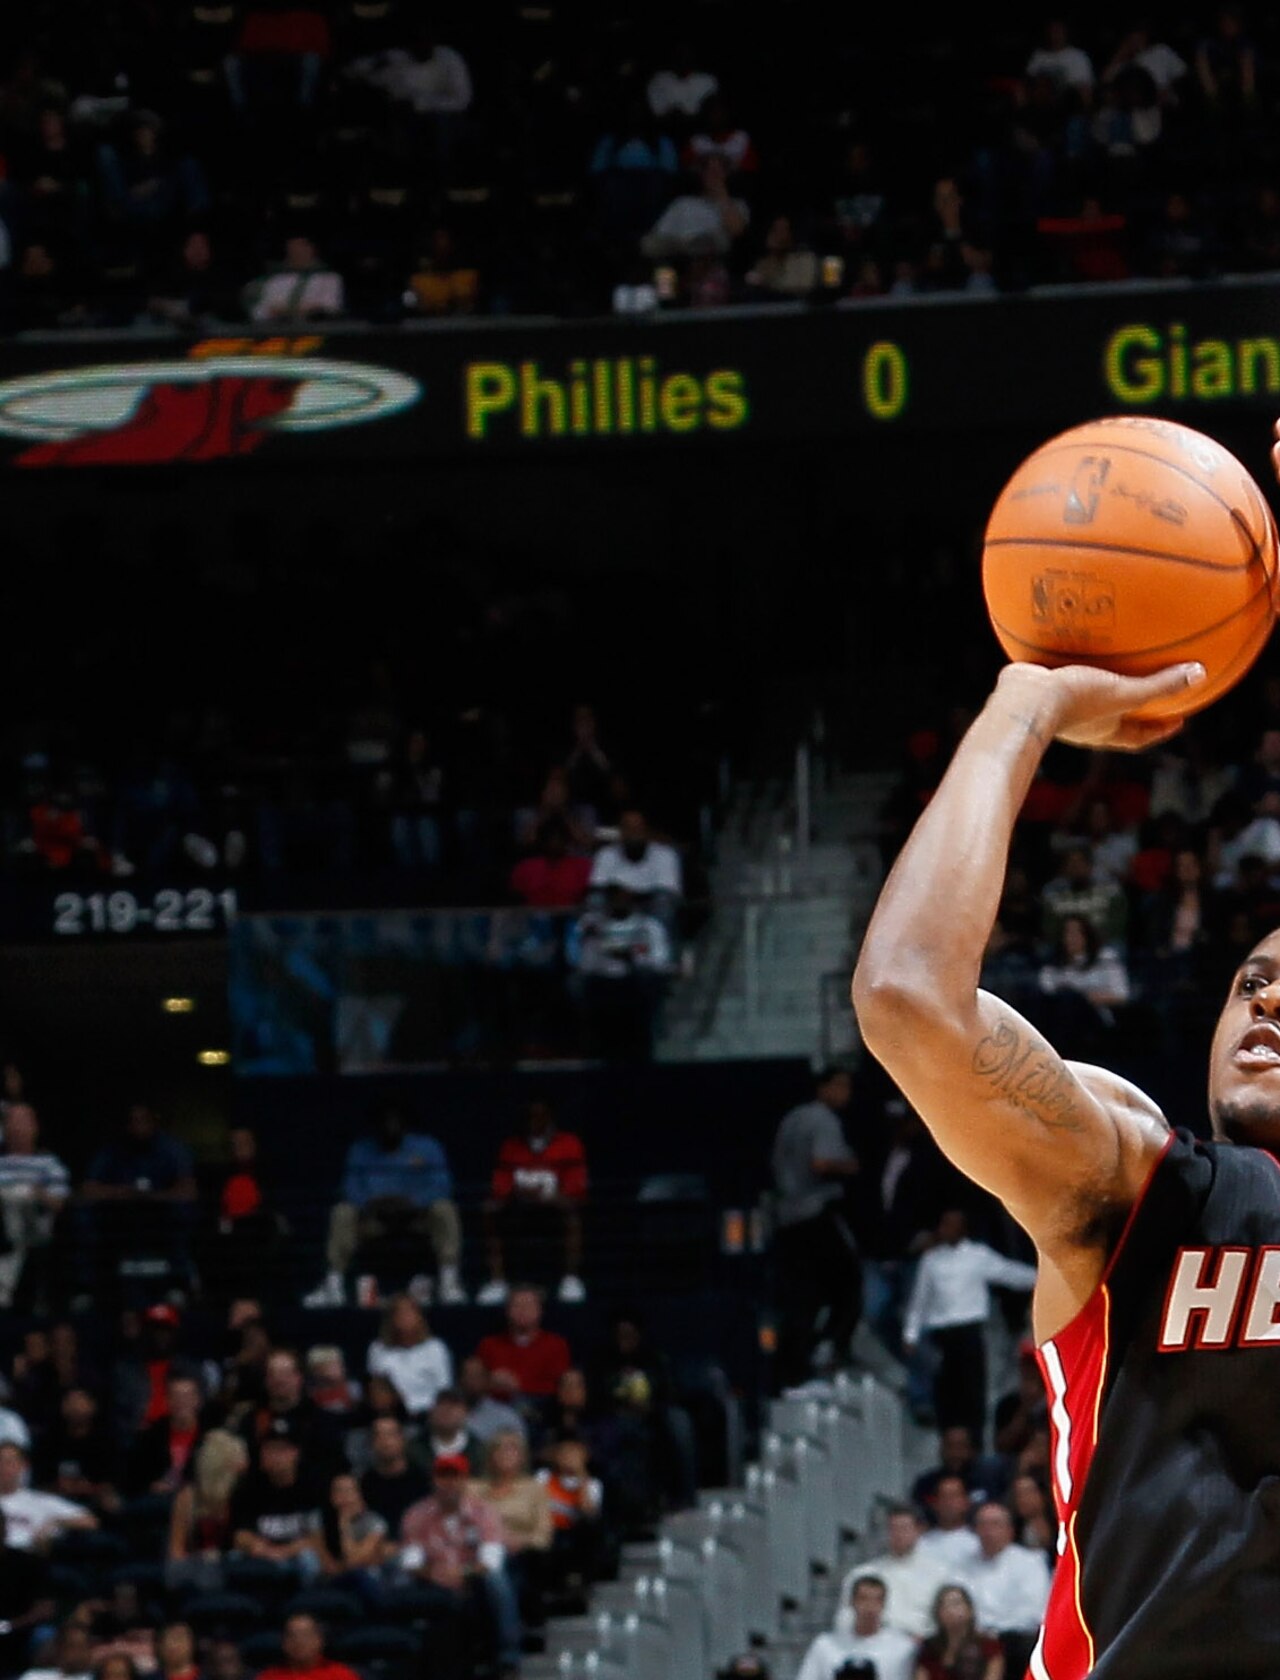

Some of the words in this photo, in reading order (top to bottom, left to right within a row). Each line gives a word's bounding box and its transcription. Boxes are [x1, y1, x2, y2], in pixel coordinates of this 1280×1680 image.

[465, 356, 749, 439] Phillies
[863, 341, 908, 421] 0
[53, 887, 238, 935] 219-221
